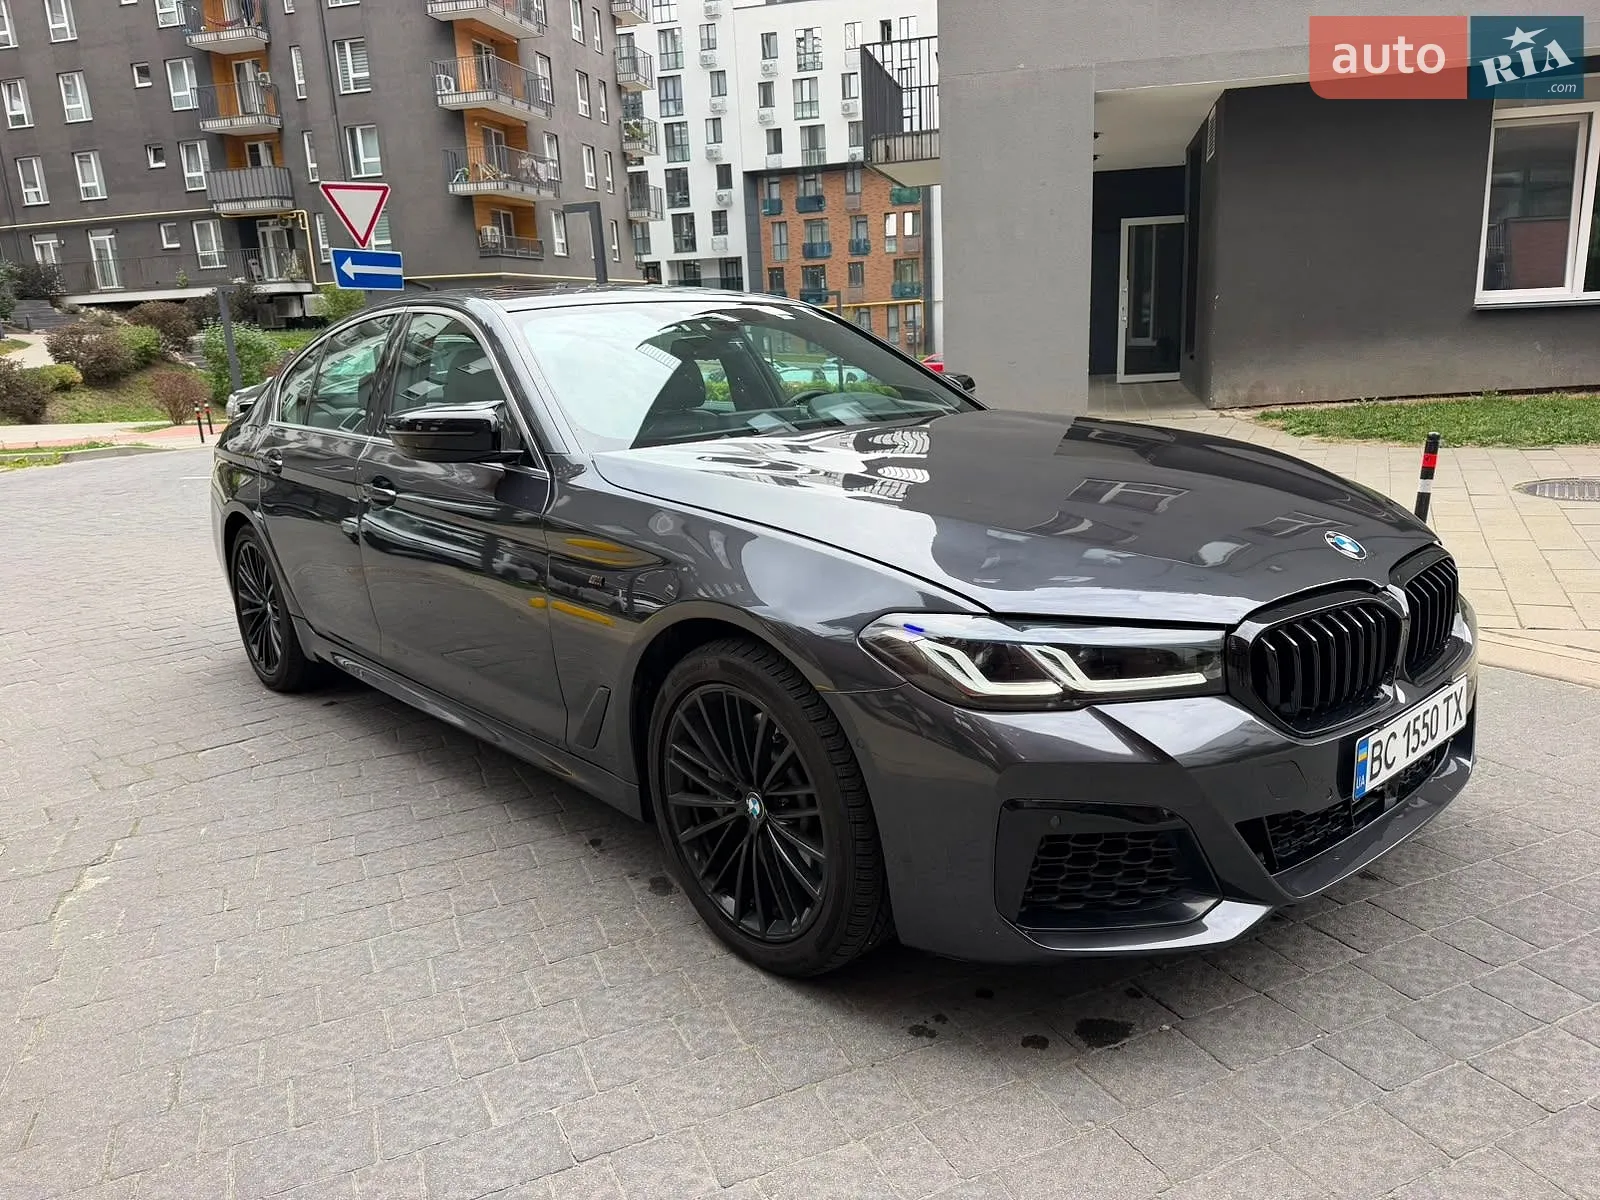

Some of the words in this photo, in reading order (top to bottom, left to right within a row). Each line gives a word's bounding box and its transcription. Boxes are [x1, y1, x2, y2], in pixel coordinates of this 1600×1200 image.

[1369, 731, 1397, 781] BC
[1402, 704, 1439, 759] 1550
[1443, 686, 1464, 732] TX
